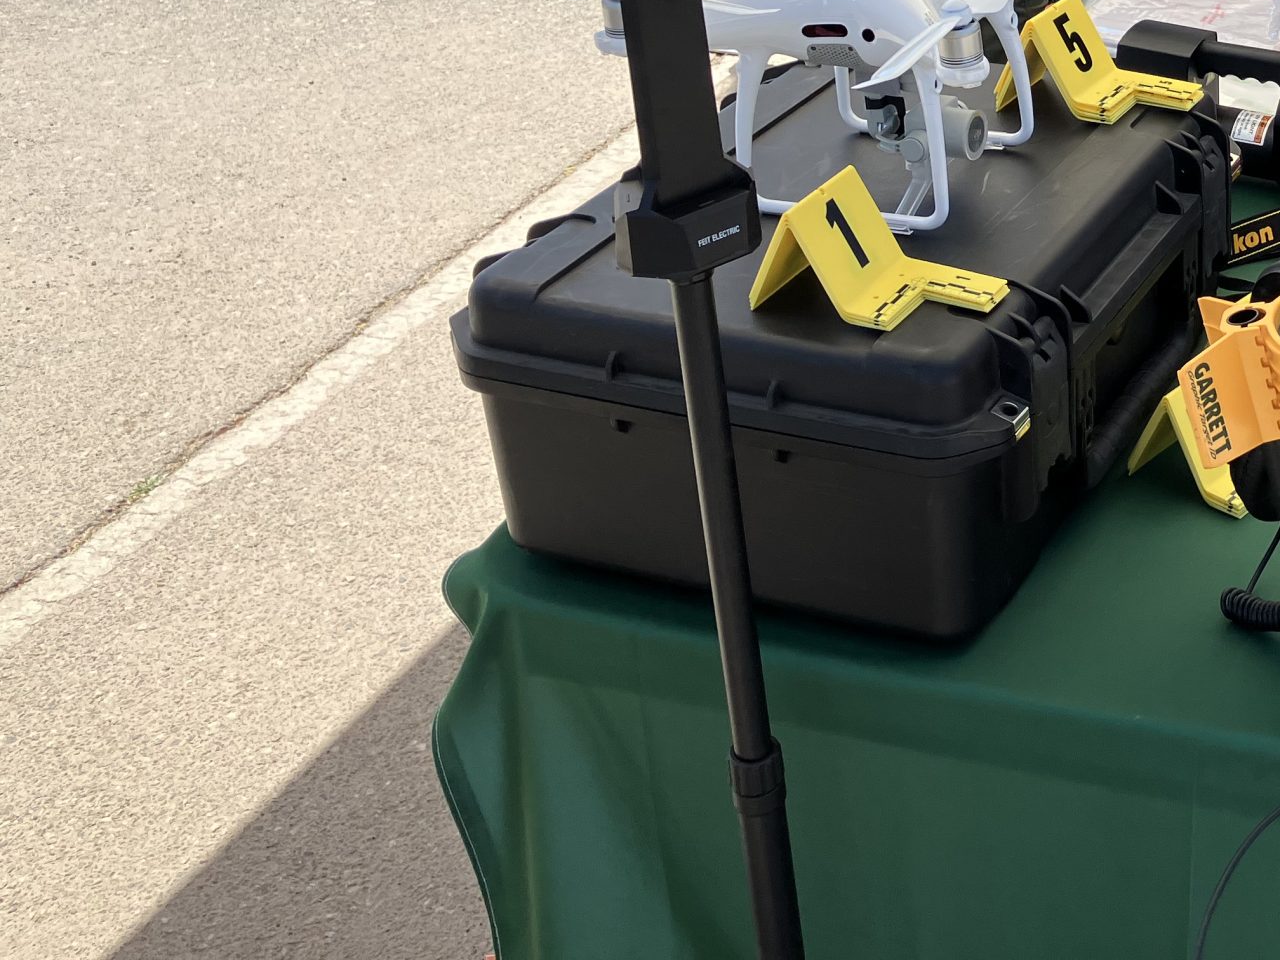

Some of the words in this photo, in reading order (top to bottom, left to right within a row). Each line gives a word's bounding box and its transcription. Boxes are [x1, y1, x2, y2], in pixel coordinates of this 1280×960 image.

[1053, 12, 1094, 73] 5
[698, 236, 711, 248] FEIT
[712, 225, 740, 242] ELECTRIC
[825, 198, 870, 269] 1
[1232, 226, 1274, 254] kon
[1187, 370, 1203, 411] Graphic
[1199, 413, 1214, 445] Target
[1194, 362, 1232, 455] GARRETT
